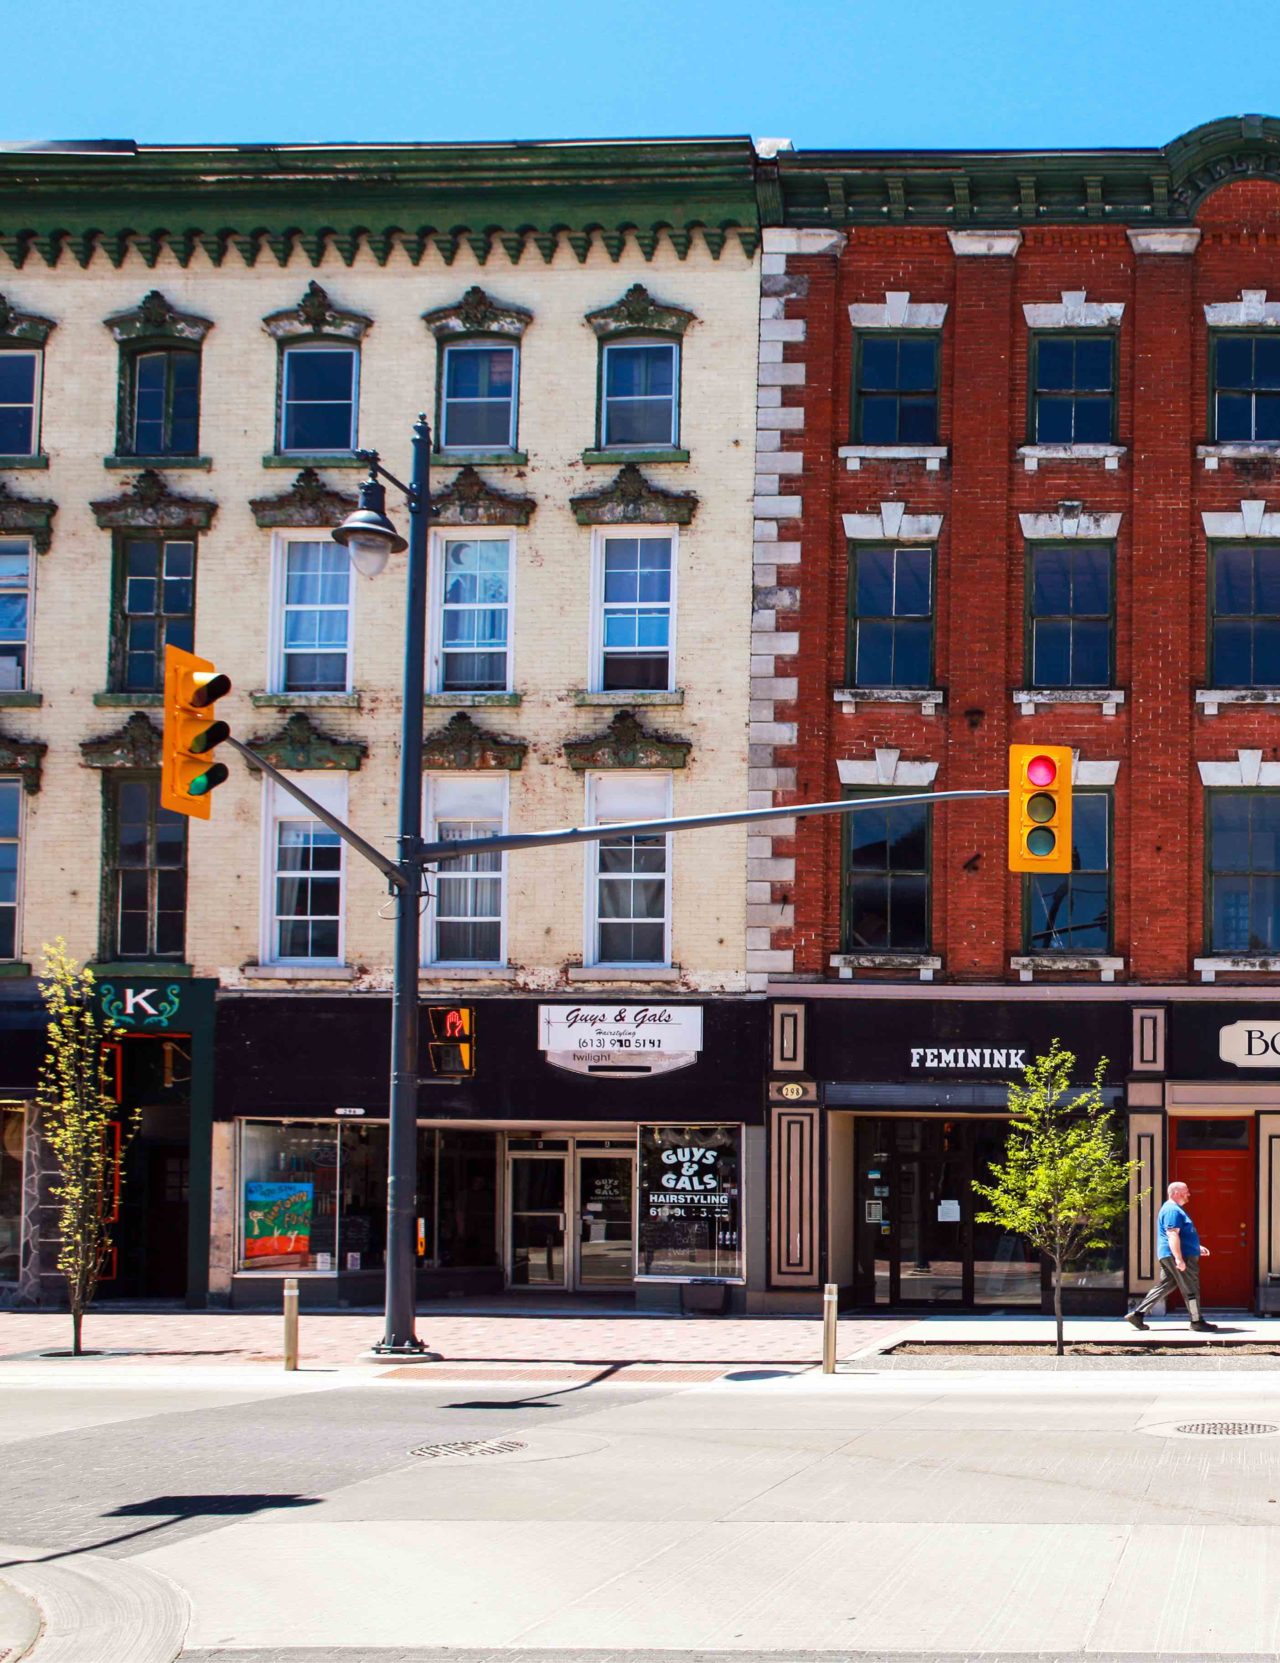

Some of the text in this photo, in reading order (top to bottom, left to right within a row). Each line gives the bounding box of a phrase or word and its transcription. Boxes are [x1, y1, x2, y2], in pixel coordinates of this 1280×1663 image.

[124, 988, 159, 1015] K
[566, 1008, 673, 1028] Guys & Gals
[595, 1028, 636, 1036] Hairstyling
[578, 1038, 605, 1048] (613)
[573, 1053, 611, 1063] twilight
[910, 1048, 1025, 1069] FEMININK
[784, 1086, 800, 1097] 298
[661, 1147, 717, 1164] GUYS
[681, 1162, 698, 1176] &
[661, 1173, 717, 1190] GALS
[649, 1194, 728, 1204] HAIRSTYLING
